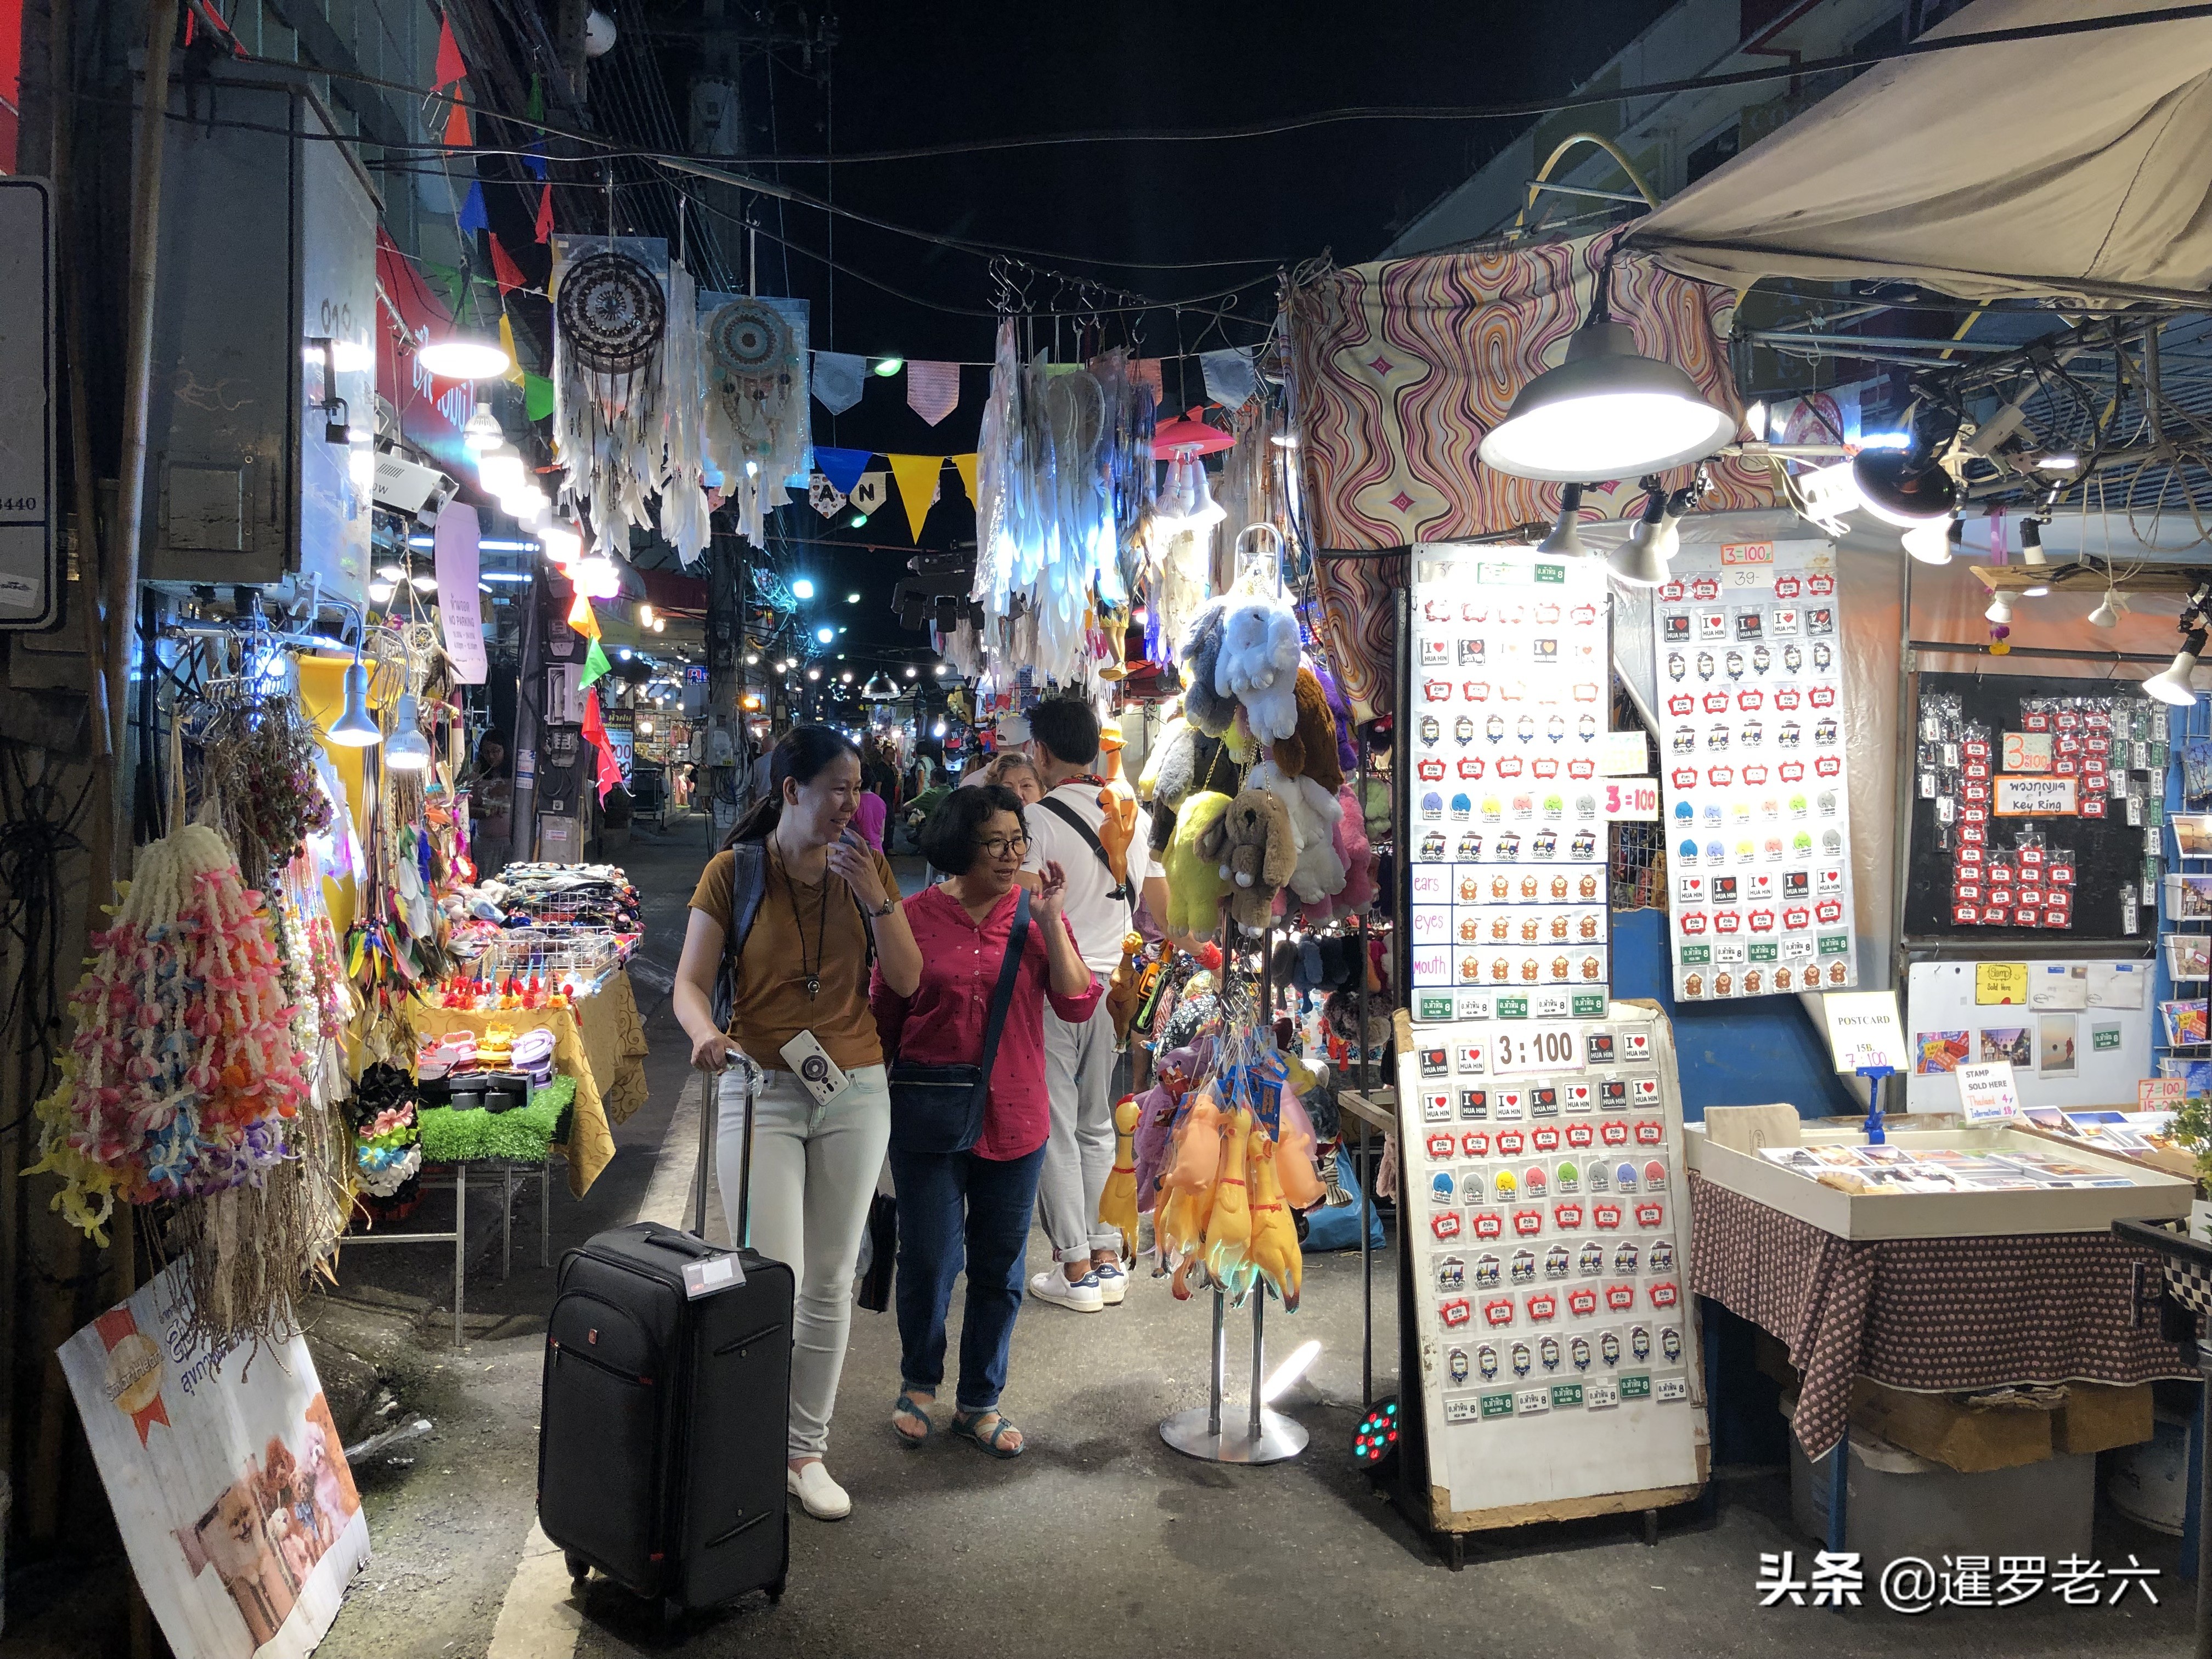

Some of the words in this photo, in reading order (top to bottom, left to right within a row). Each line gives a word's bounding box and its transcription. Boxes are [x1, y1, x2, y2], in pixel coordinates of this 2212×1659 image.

[818, 484, 836, 503] A
[859, 483, 875, 503] N
[0, 497, 36, 511] 440
[1558, 571, 1563, 579] 8
[448, 615, 456, 625] NO
[456, 616, 475, 628] PARKING
[2010, 782, 2066, 797] พวงกุญแจ
[1634, 788, 1656, 811] 100
[2038, 799, 2062, 812] Ring
[1414, 877, 1440, 891] ears
[1414, 915, 1443, 935] eyes
[1841, 940, 1846, 948] 8
[1991, 967, 2010, 979] Stamp
[1987, 983, 1998, 991] Sold
[1444, 1003, 1451, 1012] 8
[1520, 1003, 1526, 1011] 8
[1560, 1001, 1565, 1009] 8
[1595, 1000, 1601, 1008] 8
[1838, 1015, 1890, 1025] POSTCARD
[2113, 1034, 2118, 1042] 8
[1499, 1035, 1512, 1065] 3
[1533, 1032, 1572, 1062] 100
[1867, 1051, 1887, 1067] 100
[1966, 1069, 1989, 1078] STAMP
[1968, 1082, 1987, 1091] SOLD
[1989, 1080, 2007, 1088] HERE
[1966, 1095, 1996, 1107] Thailand
[1970, 1108, 2002, 1118] International
[1643, 1381, 1649, 1390] 8
[1679, 1384, 1684, 1393] 8
[1575, 1389, 1581, 1398] 8
[1610, 1391, 1616, 1400] 8
[1505, 1399, 1511, 1408] 8
[1541, 1396, 1547, 1404] 8
[1470, 1404, 1476, 1413] 8
